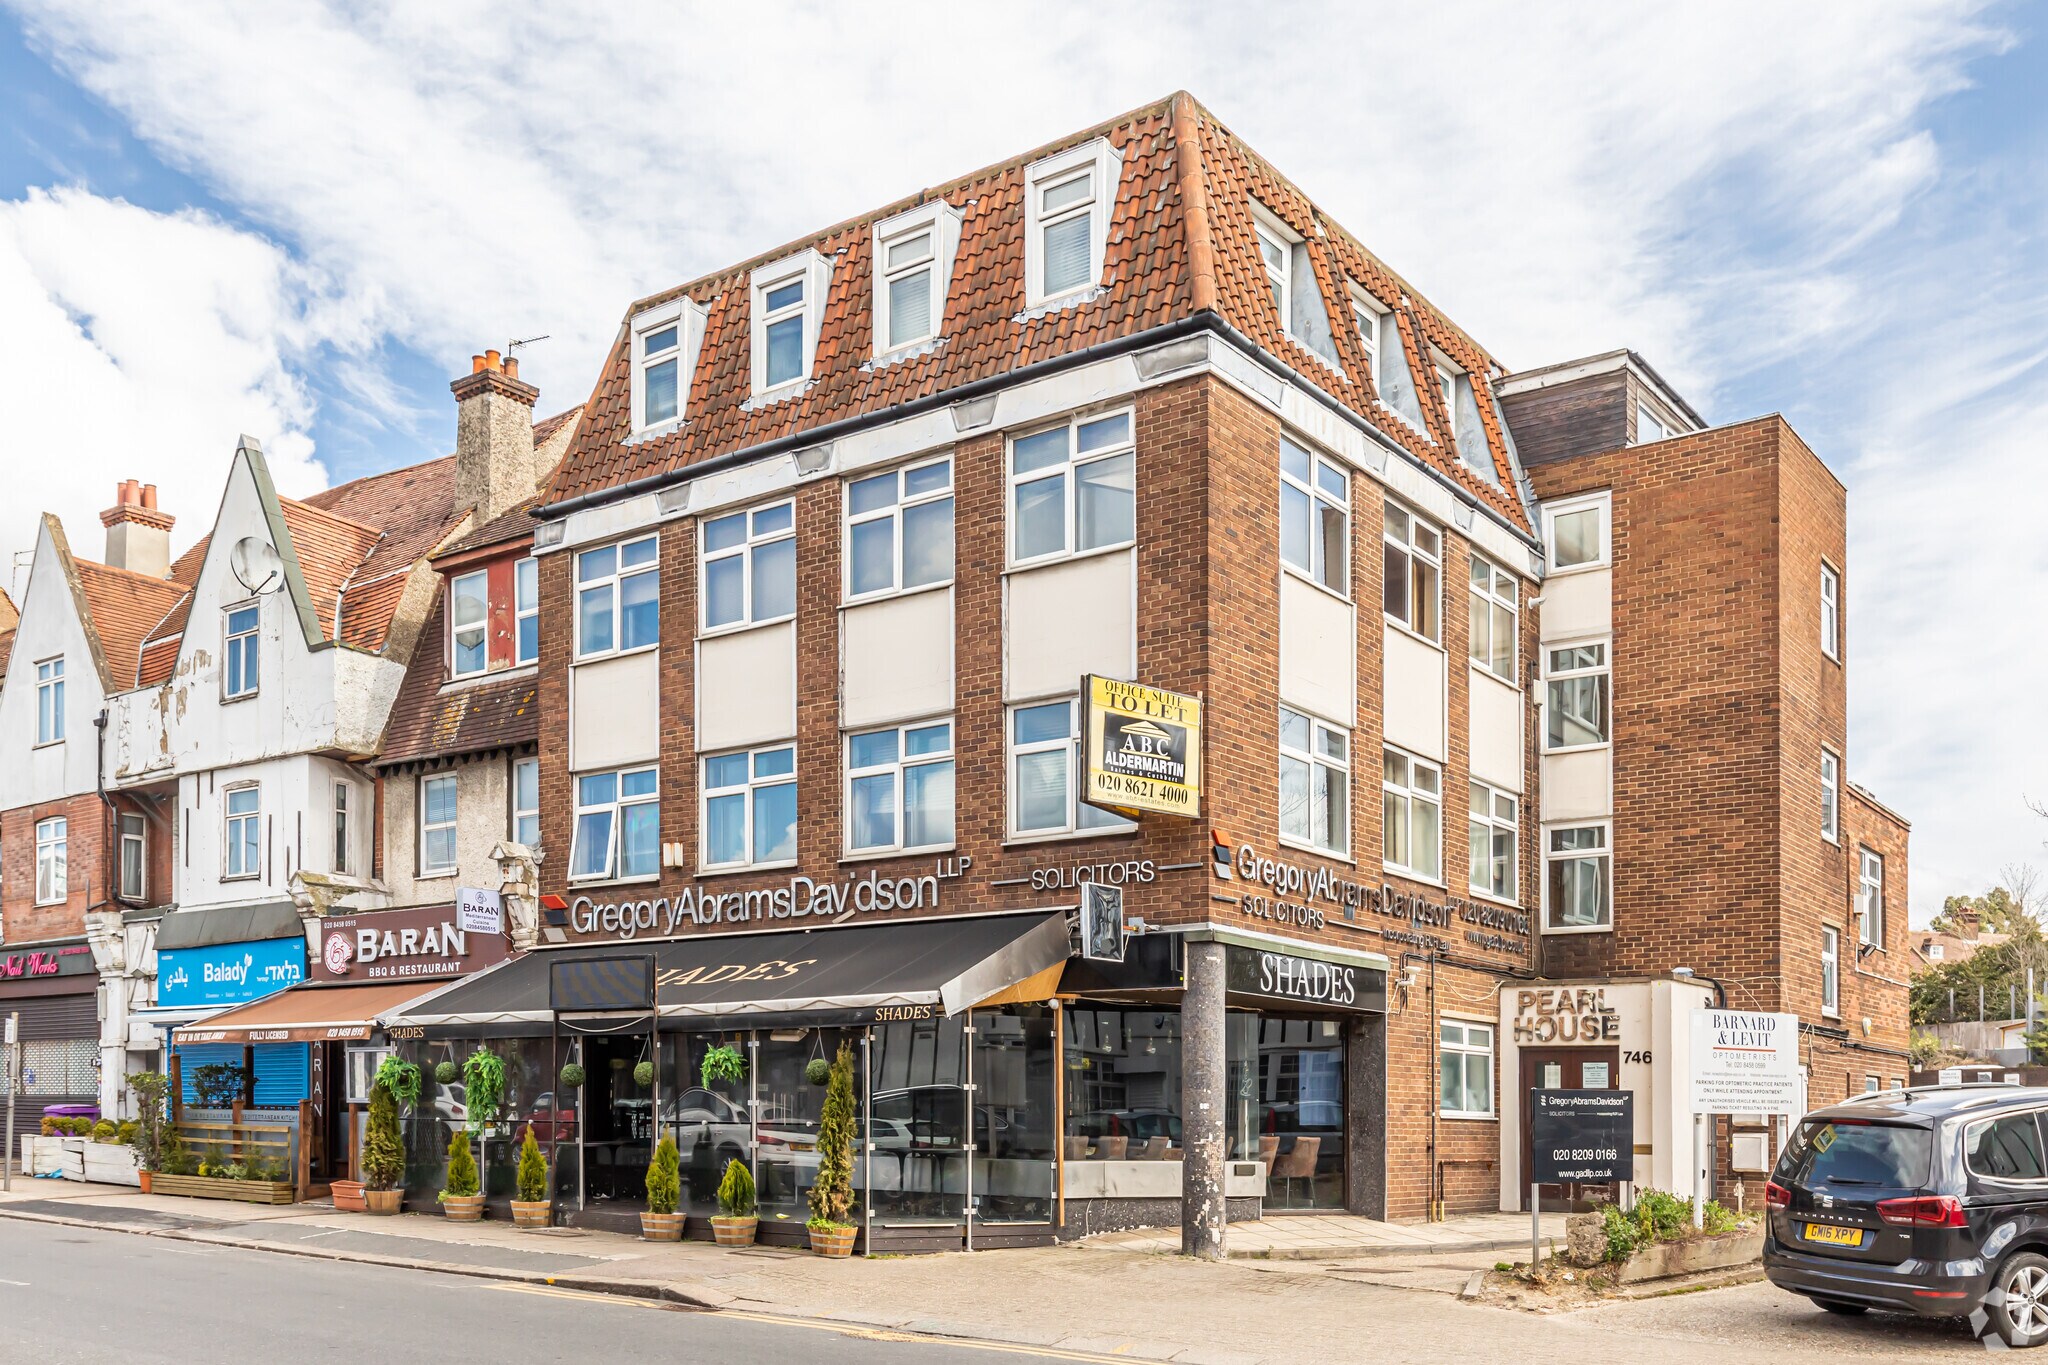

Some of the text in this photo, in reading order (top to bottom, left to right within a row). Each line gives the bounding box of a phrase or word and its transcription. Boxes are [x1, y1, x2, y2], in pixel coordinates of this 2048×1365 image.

[1105, 680, 1184, 708] OFFICE SUITE
[1106, 692, 1188, 722] TO LET
[1122, 733, 1169, 757] ABC
[1105, 750, 1185, 778] ALDERMARTIN
[1110, 765, 1135, 775] Baines
[1147, 771, 1178, 783] Cuthbert
[1098, 774, 1188, 804] 020 8621 4000
[937, 857, 971, 879] LLP
[1031, 860, 1155, 891] SOLICITORS
[463, 903, 499, 916] BARAN
[465, 913, 497, 921] Mediterranean
[1242, 894, 1325, 931] SOLICITORS
[357, 922, 466, 963] BARAN
[28, 952, 59, 975] Works
[203, 960, 248, 985] Balady
[369, 962, 461, 977] BBQ & RESTAURANT
[657, 959, 819, 986] ADES
[1259, 954, 1356, 1005] SHADES
[1518, 988, 1615, 1016] PEARL
[875, 1005, 931, 1022] SHADES
[1713, 1014, 1776, 1032] BARNARD
[249, 1030, 289, 1041] FULLY LICENSED
[389, 1026, 425, 1039] SHADES
[1513, 1015, 1621, 1042] HOUSE
[1717, 1030, 1771, 1047] & LEVIT
[1623, 1050, 1653, 1064] 746
[1712, 1051, 1777, 1061] OPTOMETRISTS
[313, 1040, 323, 1118] ARAN
[1548, 1096, 1624, 1107] GregoryAbramsDavidson
[1553, 1149, 1617, 1161] 020 8209 0166
[1558, 1168, 1613, 1179] www.gadllp.co.uk
[1811, 1225, 1855, 1242] GM16 XPY
